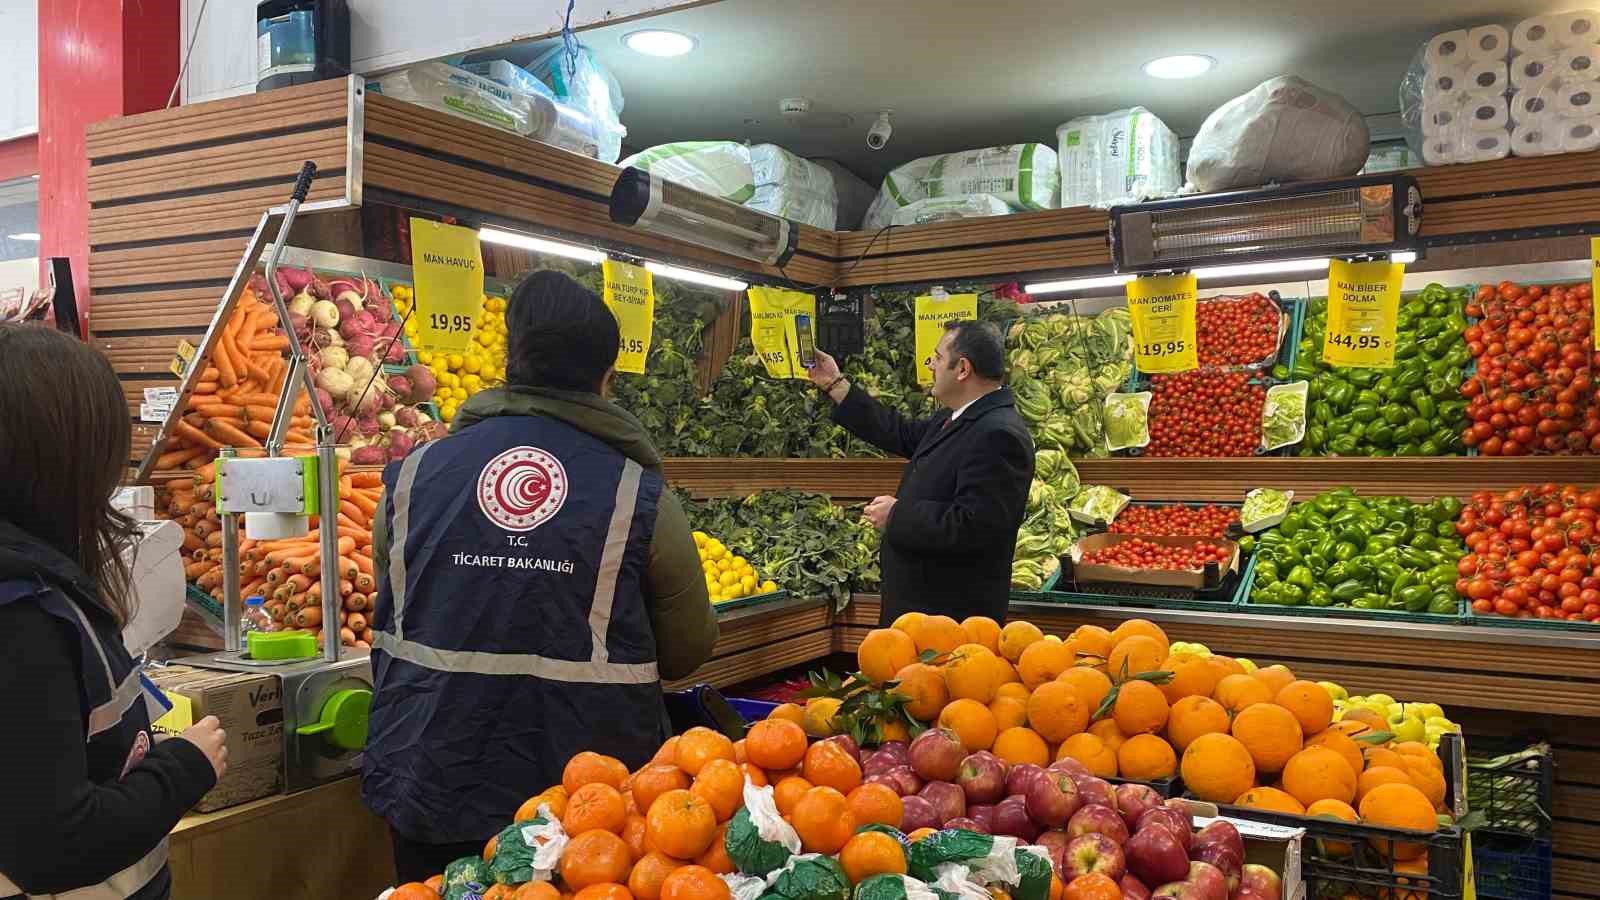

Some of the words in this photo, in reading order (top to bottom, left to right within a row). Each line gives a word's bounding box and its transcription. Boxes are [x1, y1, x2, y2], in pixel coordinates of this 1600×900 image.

[423, 252, 475, 270] MAN.HAVUÇ
[1337, 281, 1388, 293] MAN.BİBER
[1343, 292, 1377, 303] DOLMA
[430, 312, 471, 334] 19,95
[1137, 341, 1185, 358] 119,95
[1328, 331, 1381, 351] 144,95
[506, 535, 529, 547] T.C.
[451, 551, 506, 567] TİCARET
[507, 556, 575, 574] BAKANLIĞI
